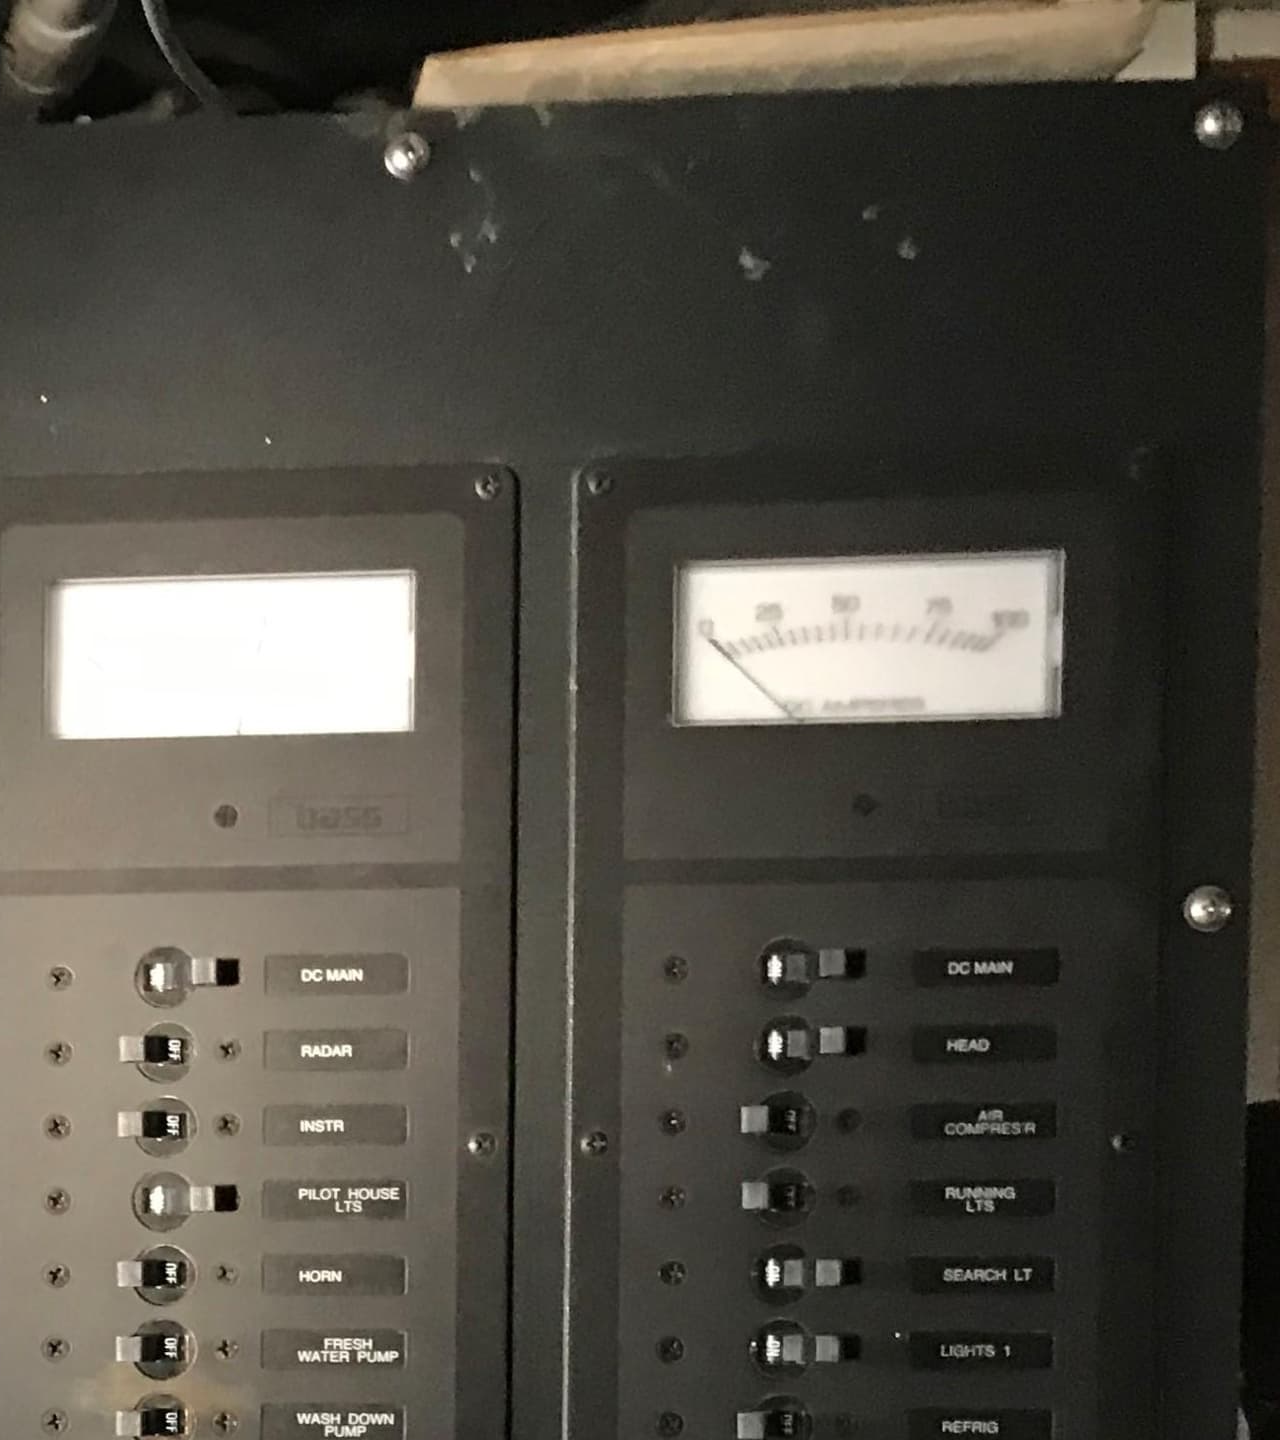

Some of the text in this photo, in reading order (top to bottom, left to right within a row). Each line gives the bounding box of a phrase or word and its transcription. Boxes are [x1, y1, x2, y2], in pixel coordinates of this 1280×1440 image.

[948, 961, 1013, 974] DC MAIN
[301, 969, 363, 982] DC MAIN
[168, 1040, 181, 1062] OFF
[301, 1045, 352, 1058] RADAR
[947, 1039, 990, 1052] HEAD
[979, 1110, 1003, 1121] AIR
[166, 1115, 179, 1136] OFF
[300, 1120, 344, 1133] INSTR
[299, 1188, 399, 1200] PILOT HOUSE
[945, 1187, 1016, 1200] RUNNING
[335, 1201, 363, 1213] LTS
[966, 1200, 994, 1213] LTS
[299, 1271, 341, 1283] HORN
[944, 1268, 1032, 1281] SEARCH LT
[164, 1338, 177, 1359] OFF
[323, 1338, 372, 1350] FRESH
[298, 1351, 398, 1363] WATER PUMP
[941, 1345, 1010, 1358] LIGHTS 1
[165, 1411, 177, 1433] OFF
[297, 1413, 394, 1425] WASH DOWN
[324, 1425, 368, 1438] PUMP
[942, 1421, 998, 1434] REFRIG
